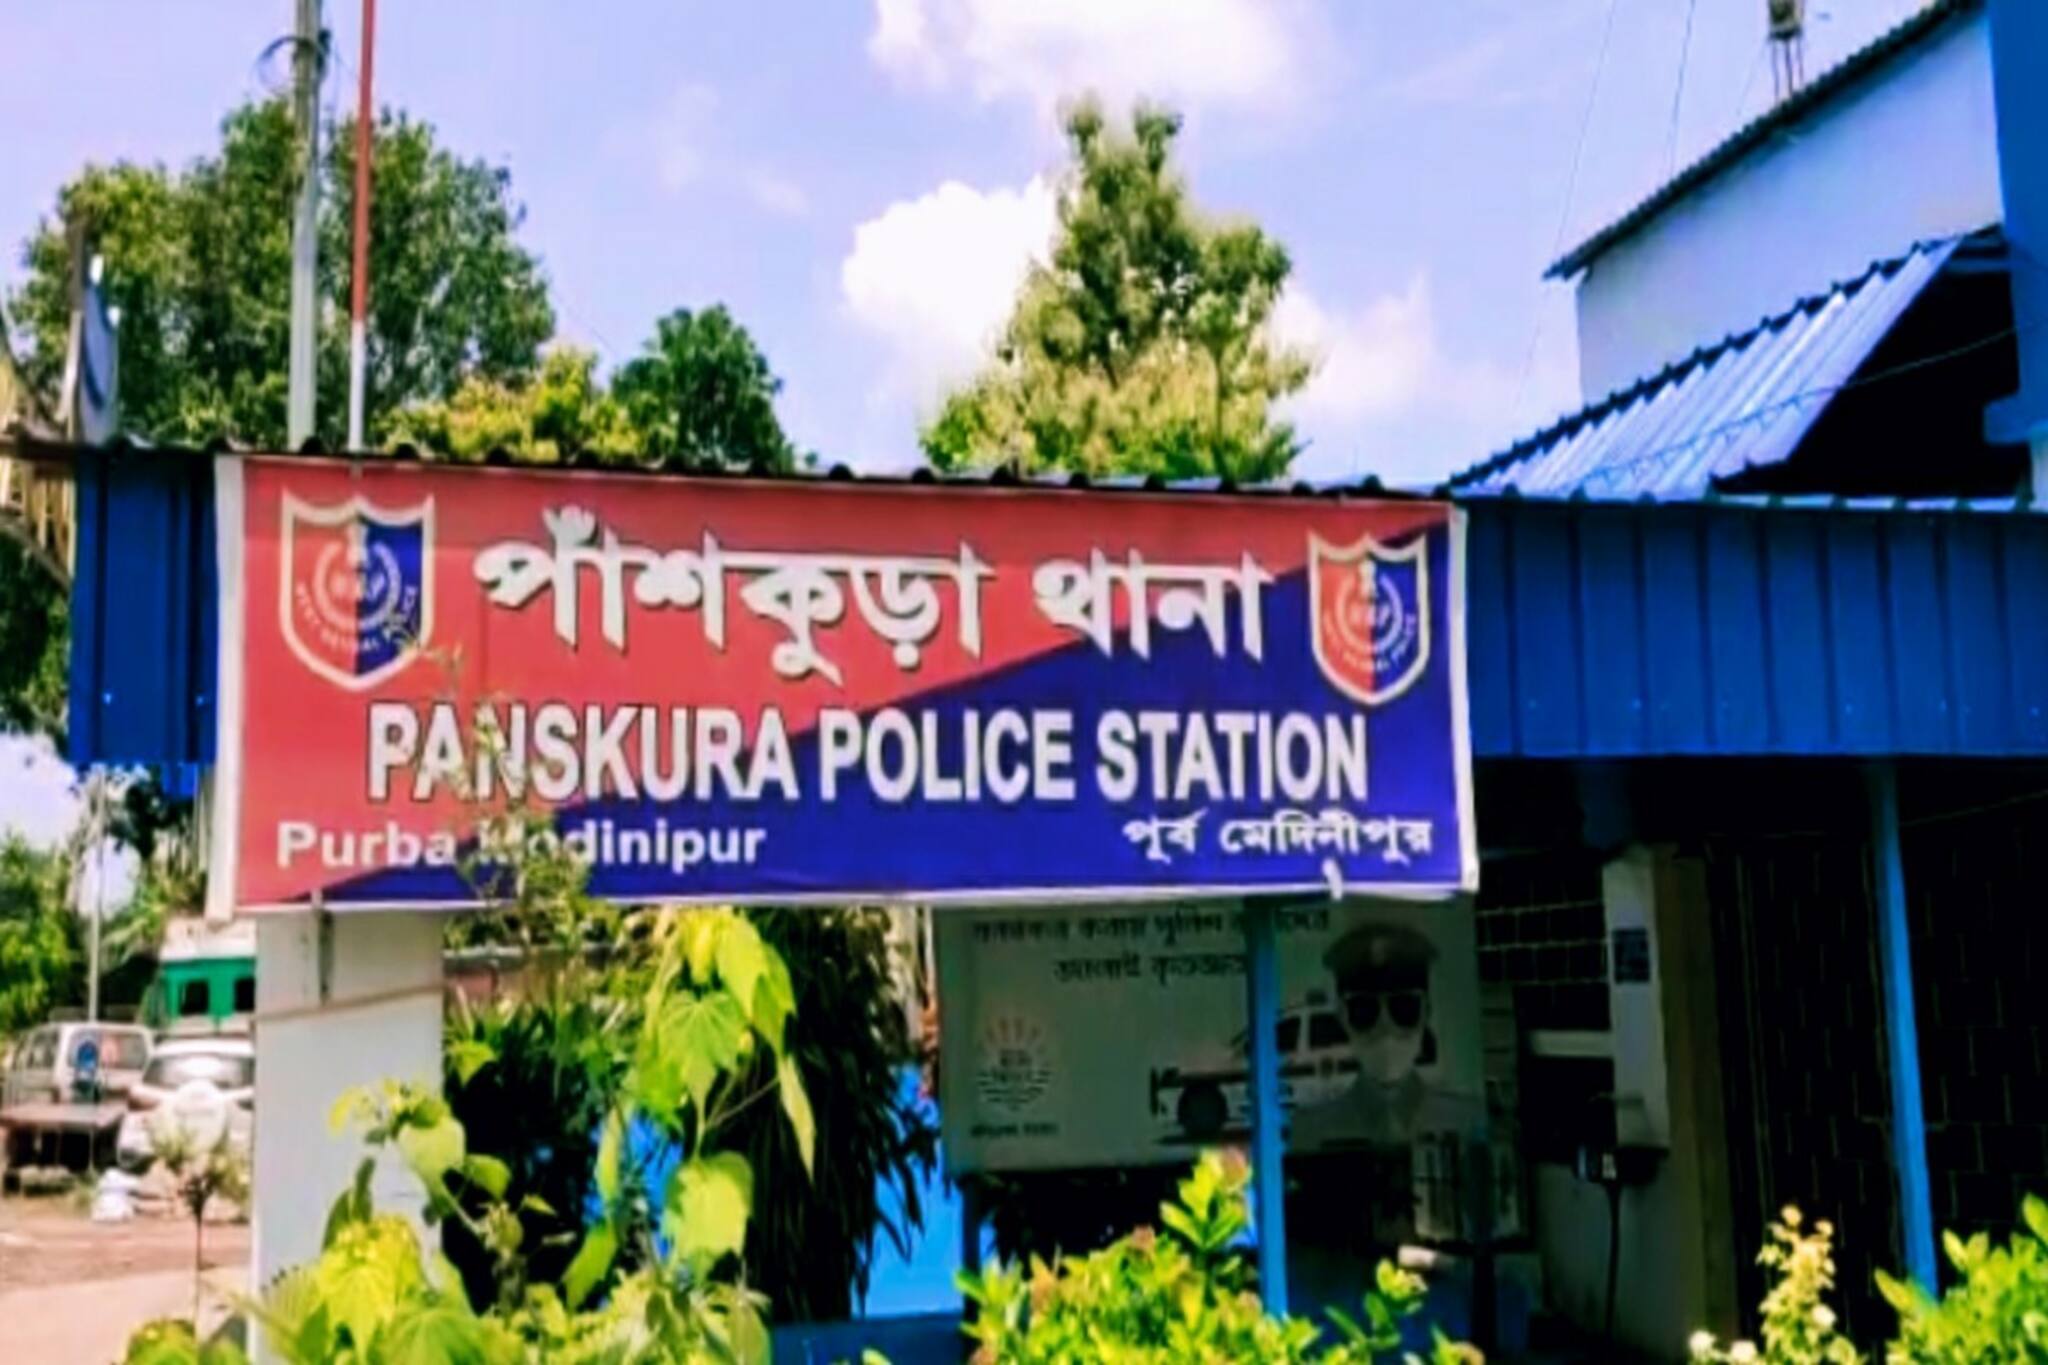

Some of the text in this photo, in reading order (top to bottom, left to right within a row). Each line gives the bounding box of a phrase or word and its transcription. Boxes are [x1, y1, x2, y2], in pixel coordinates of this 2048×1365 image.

[473, 505, 995, 686] পাঁশকুড়া
[1033, 544, 1275, 662] থানা
[366, 701, 1368, 803] PANSKURA POLICE STATION
[275, 819, 458, 869] Purba
[1121, 807, 1434, 867] পূর্ব মেদিনীপুর
